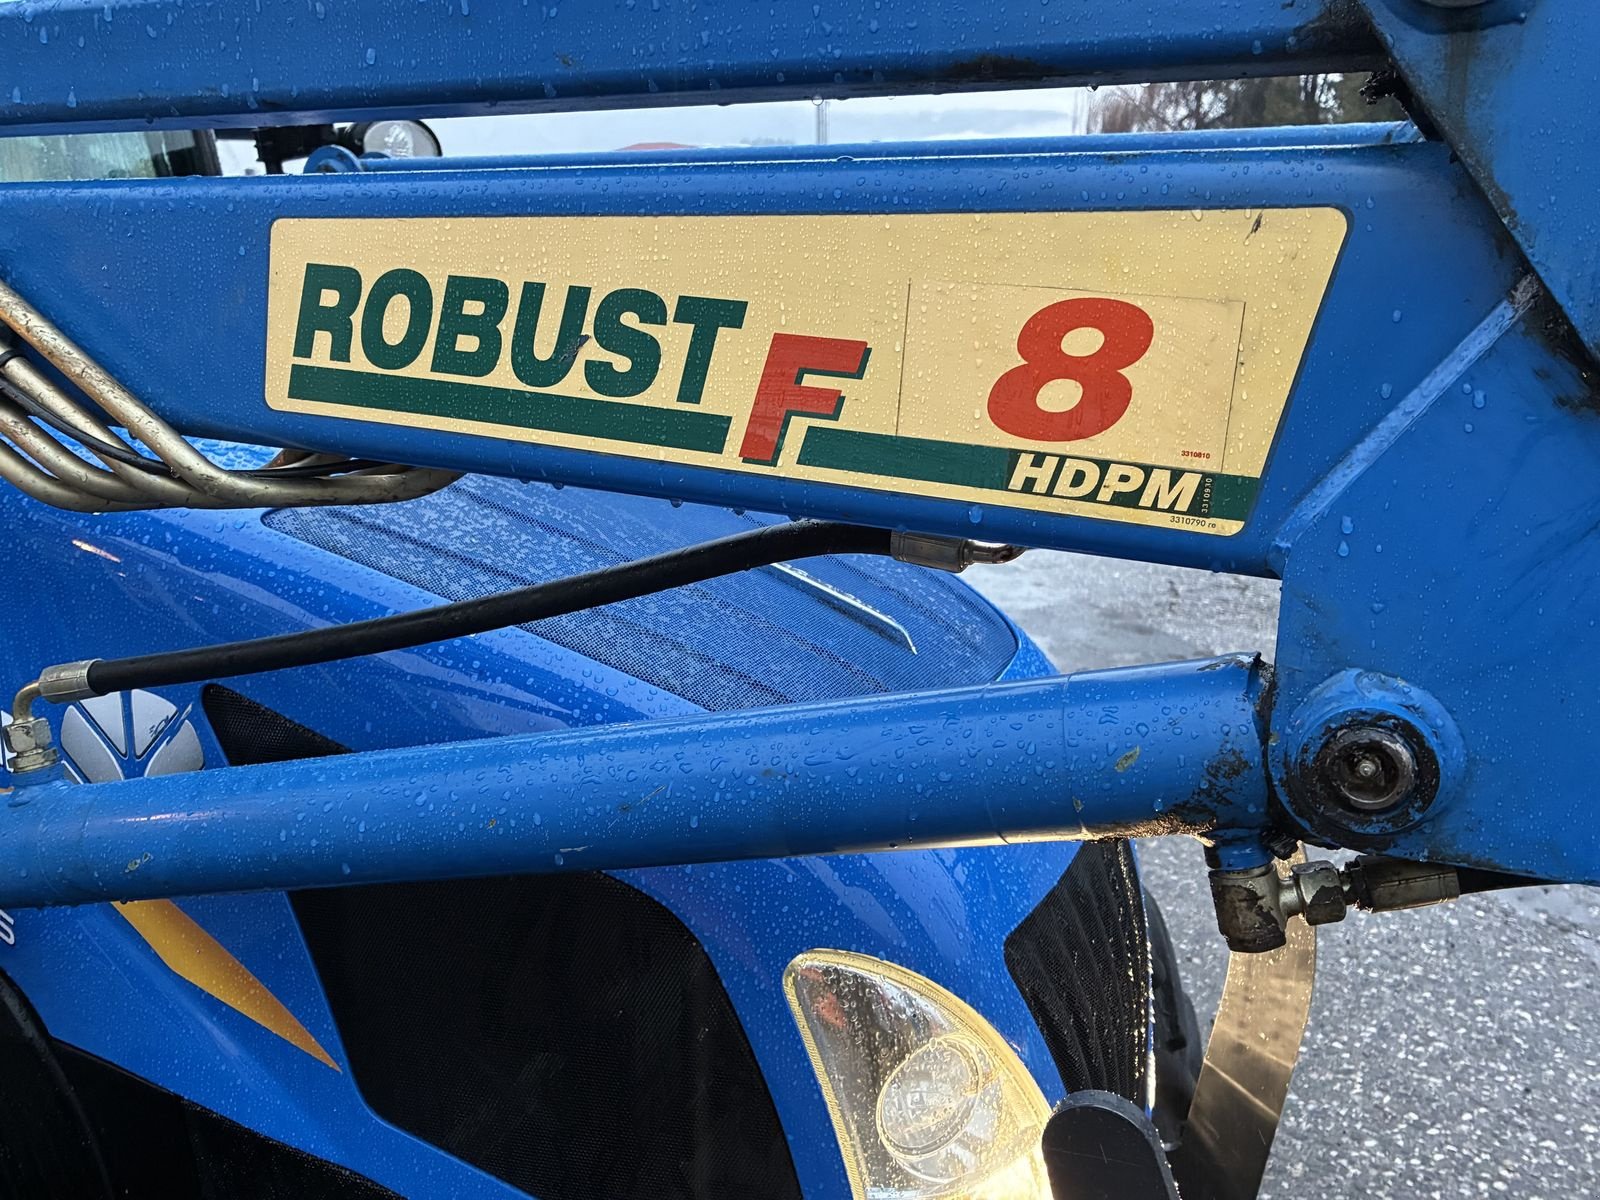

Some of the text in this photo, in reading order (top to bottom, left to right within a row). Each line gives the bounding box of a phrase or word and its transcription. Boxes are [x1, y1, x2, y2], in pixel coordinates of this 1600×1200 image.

[293, 262, 1154, 467] ROBUST F 8
[1008, 452, 1203, 513] HDPM
[1169, 515, 1206, 527] 3310790
